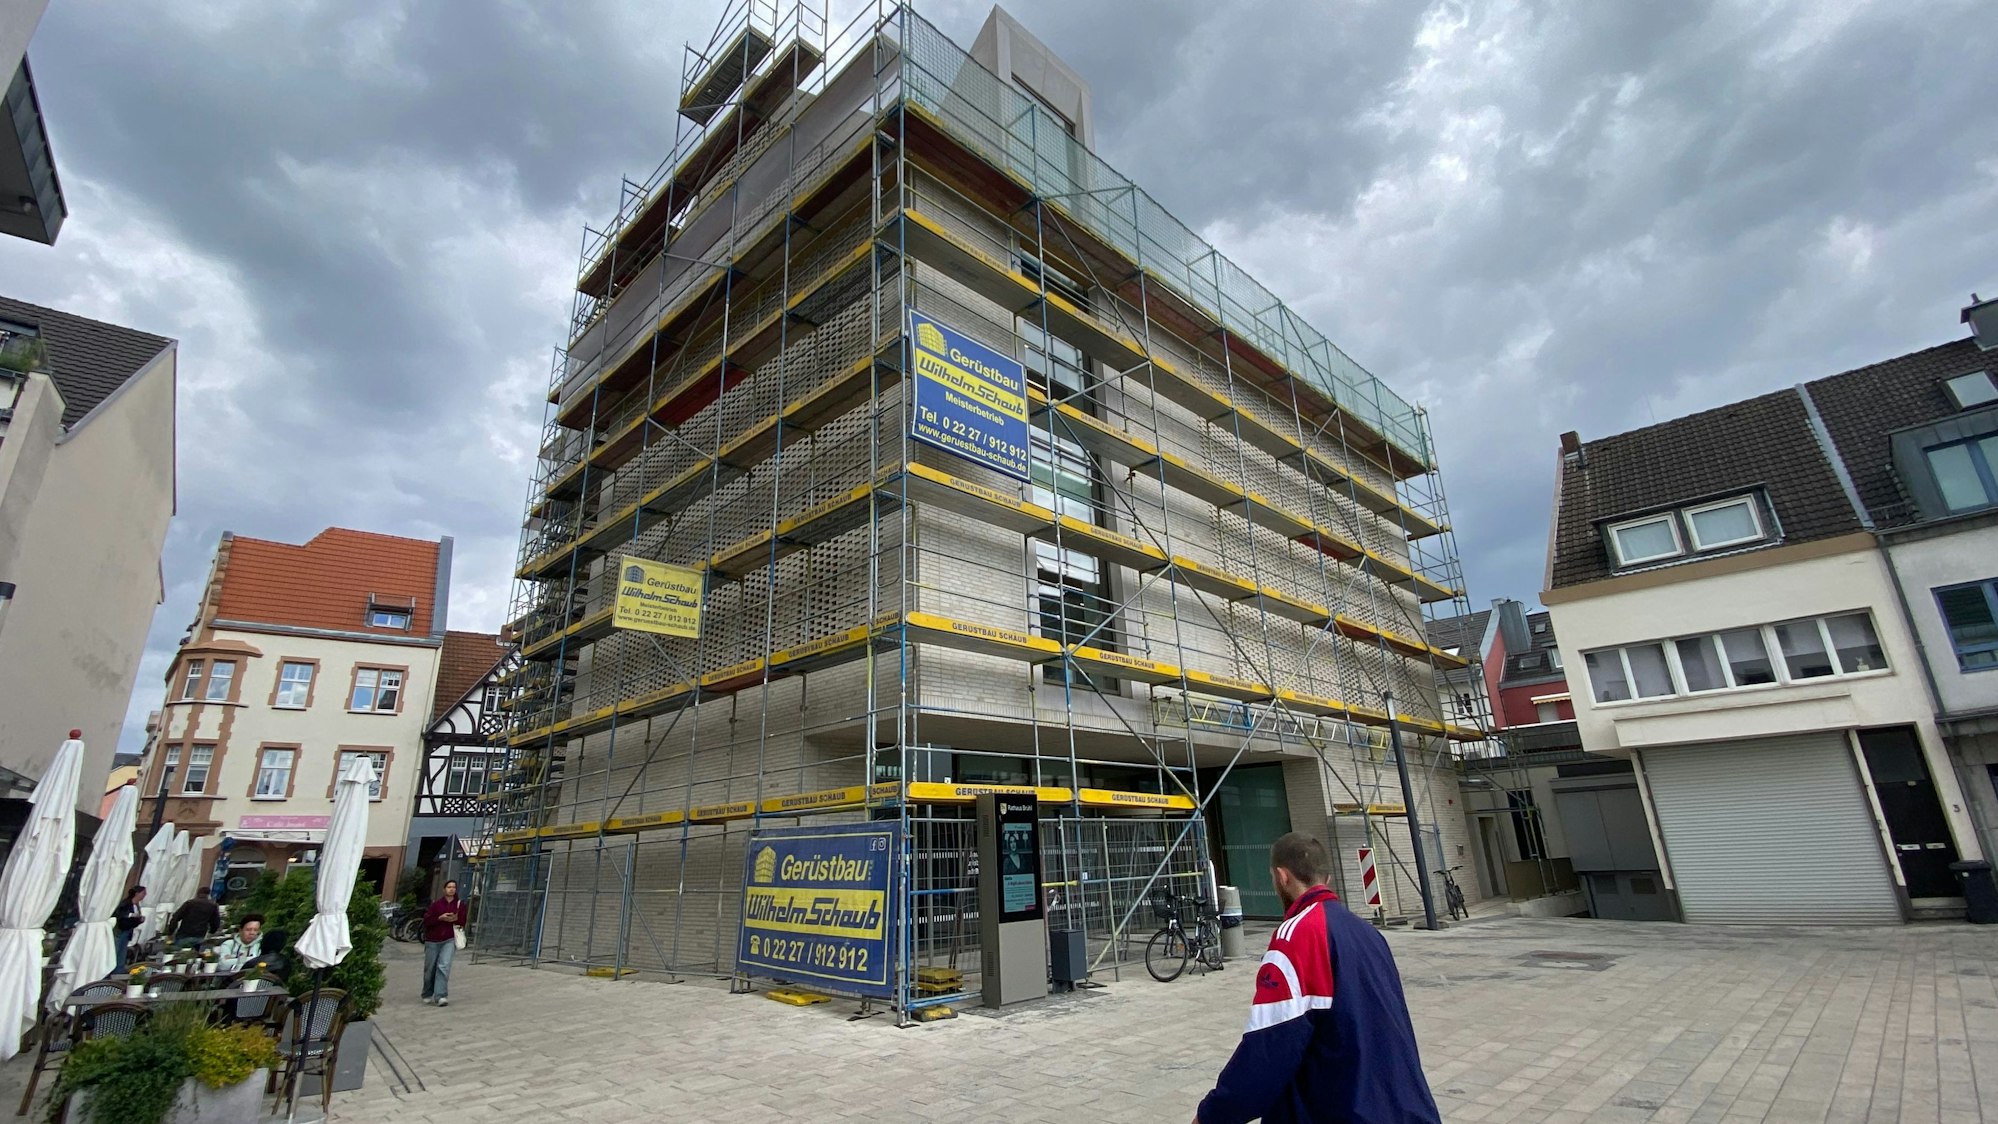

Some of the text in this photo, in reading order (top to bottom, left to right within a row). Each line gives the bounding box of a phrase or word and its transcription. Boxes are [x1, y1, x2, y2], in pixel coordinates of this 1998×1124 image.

[950, 348, 1018, 390] Gerüstbau
[946, 391, 1004, 426] Meisterbetrieb
[920, 406, 938, 425] Tel.
[943, 417, 949, 429] 0
[953, 420, 965, 434] 22
[968, 426, 981, 440] 27
[990, 436, 1007, 452] 912
[1010, 444, 1026, 461] 912
[918, 422, 1026, 472] www.geruestbau-schaub.de
[994, 494, 1020, 507] SCHAUB
[647, 578, 697, 594] Gerüstbau
[876, 613, 899, 624] SCHAUB
[824, 634, 849, 646] SCHAUB
[999, 632, 1027, 643] SCHAUB
[1134, 660, 1154, 669] SCHAUB
[819, 792, 845, 802] SCHAUB
[872, 786, 897, 795] SCHAUB
[781, 854, 869, 881] Gerüstbau
[764, 940, 770, 957] 0
[773, 940, 786, 960] 22
[789, 942, 804, 961] 27
[815, 944, 835, 968] 912
[839, 947, 868, 971] 912
